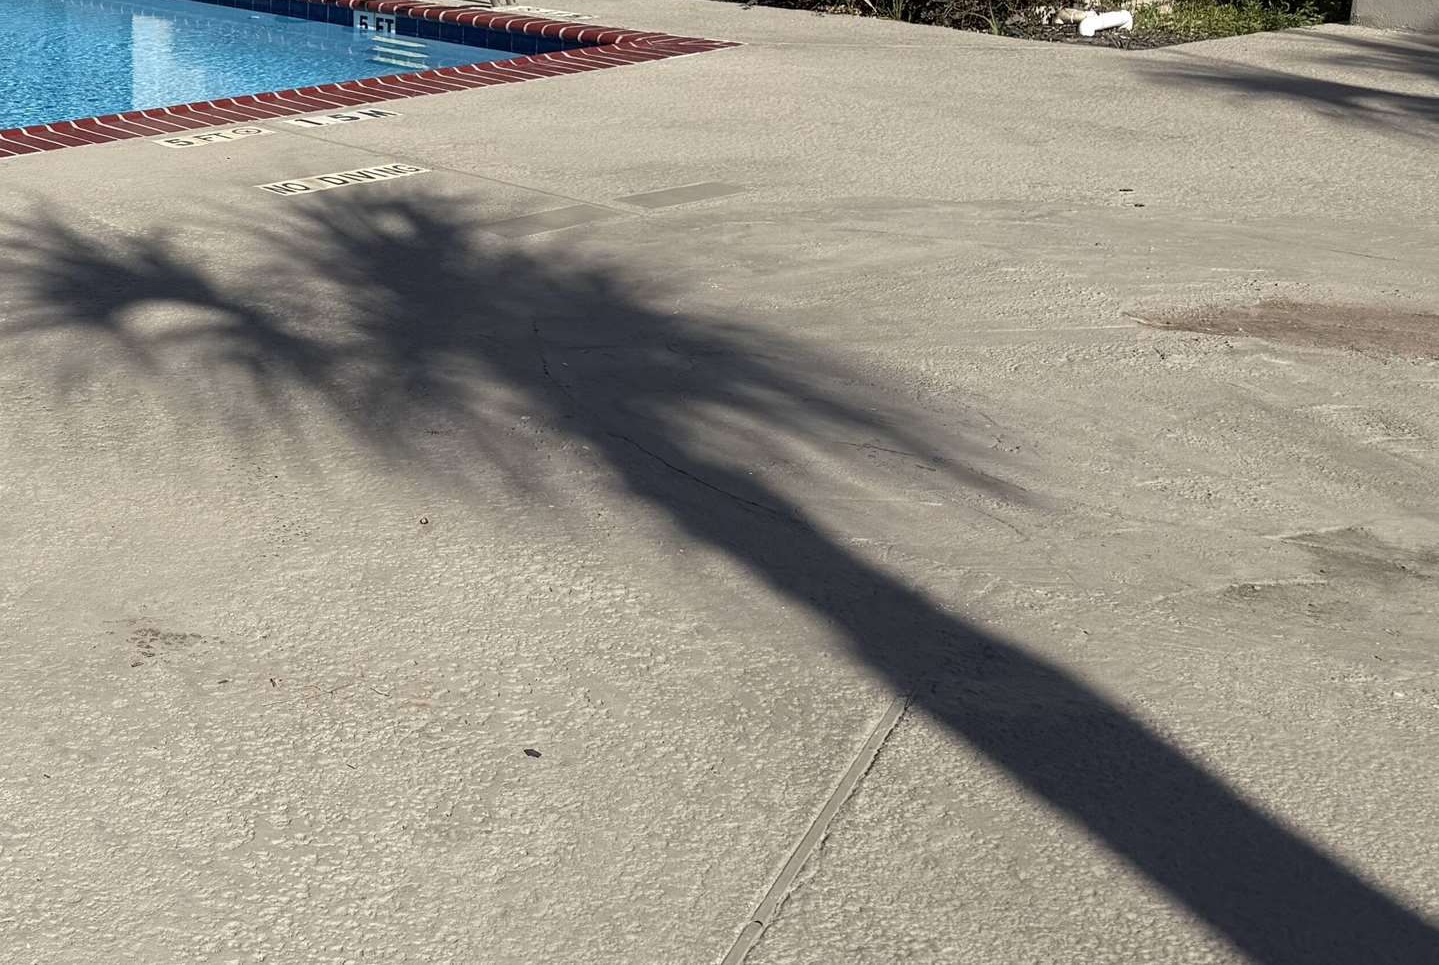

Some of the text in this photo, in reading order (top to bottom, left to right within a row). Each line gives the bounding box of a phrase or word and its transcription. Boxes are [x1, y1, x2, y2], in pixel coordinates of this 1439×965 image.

[359, 15, 394, 33] 5 FT
[357, 109, 398, 119] M
[164, 132, 233, 147] 5 FT
[263, 164, 420, 194] NO DIVING
